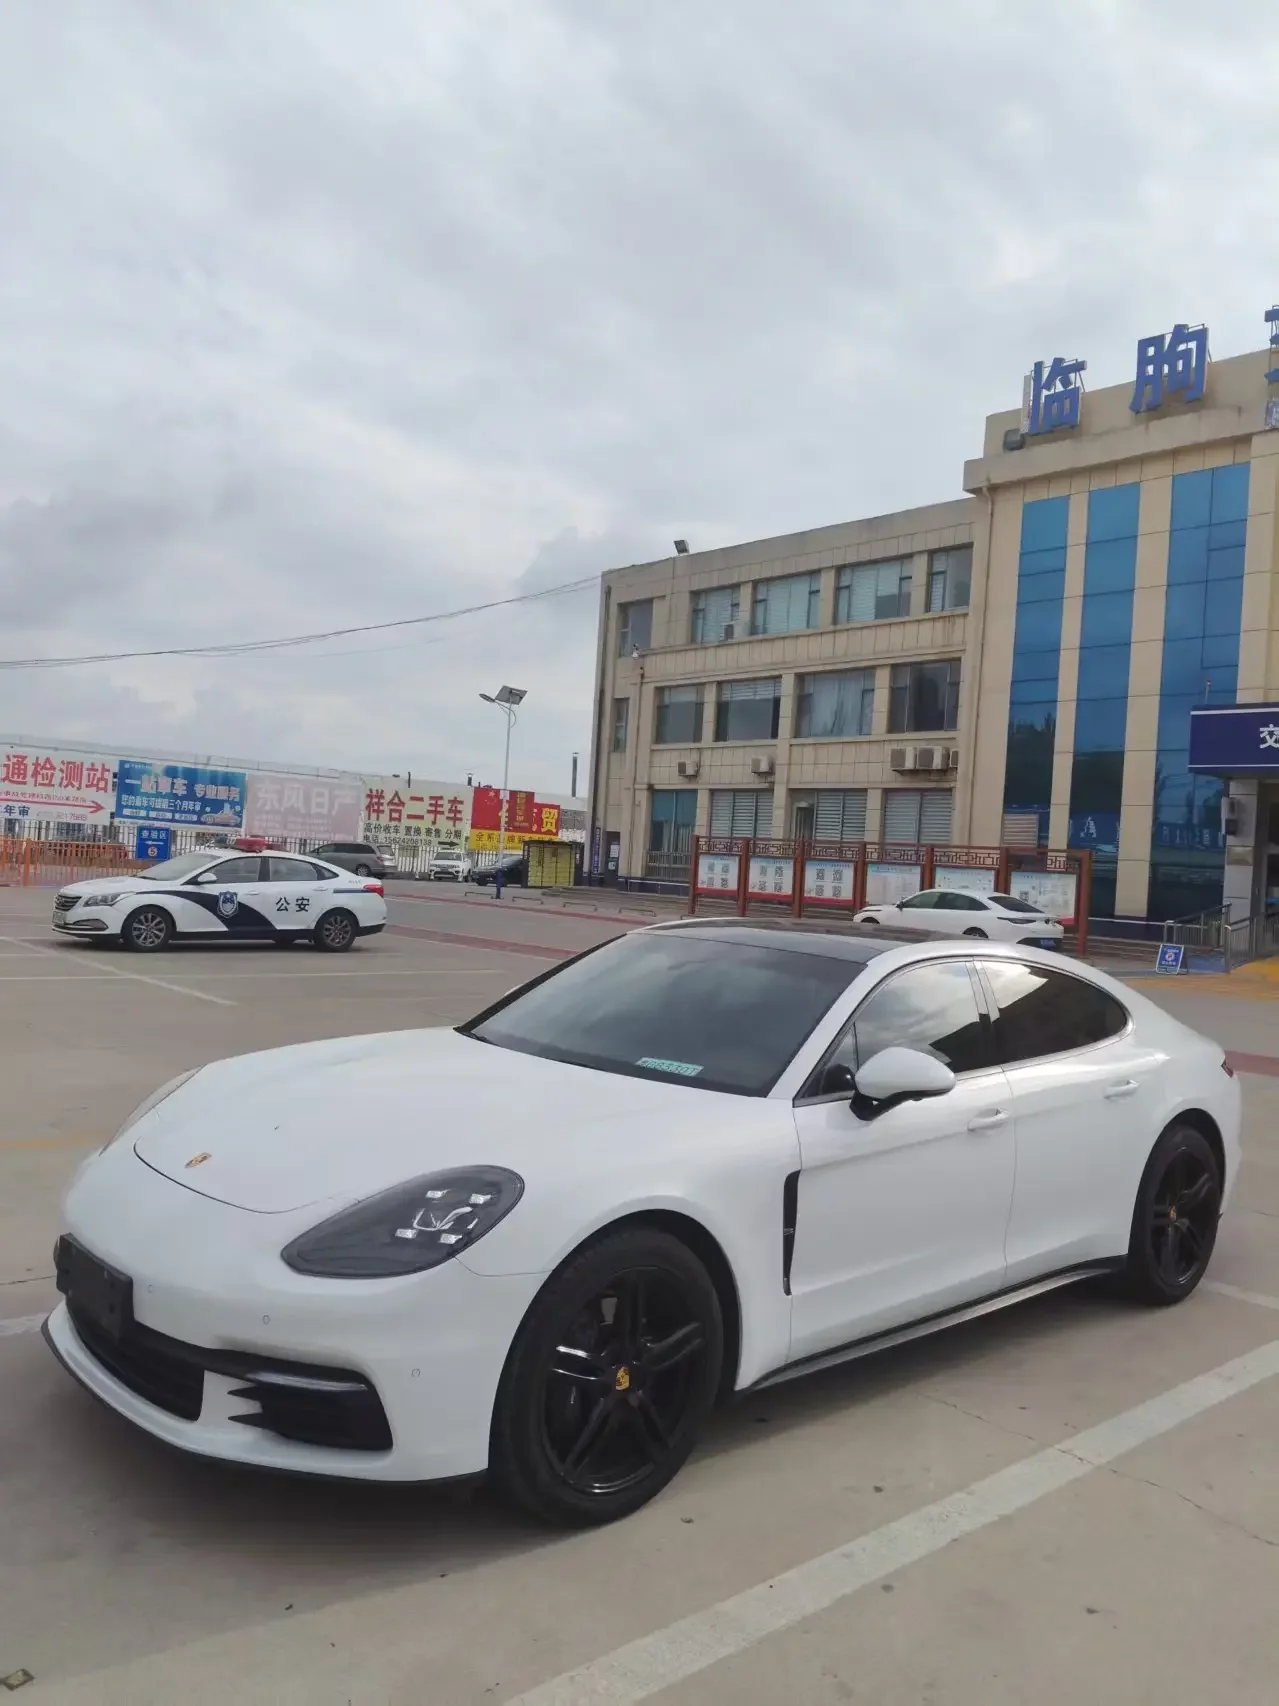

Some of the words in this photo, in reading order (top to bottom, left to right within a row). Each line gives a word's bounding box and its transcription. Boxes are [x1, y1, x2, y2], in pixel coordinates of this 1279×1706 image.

[1, 754, 110, 793] 通检测站
[255, 779, 356, 816] 东风日产
[365, 788, 464, 828] 祥合二手车
[364, 822, 400, 836] 高价收车
[404, 825, 422, 837] 置换
[445, 829, 462, 840] 分期
[275, 897, 310, 912] 公安
